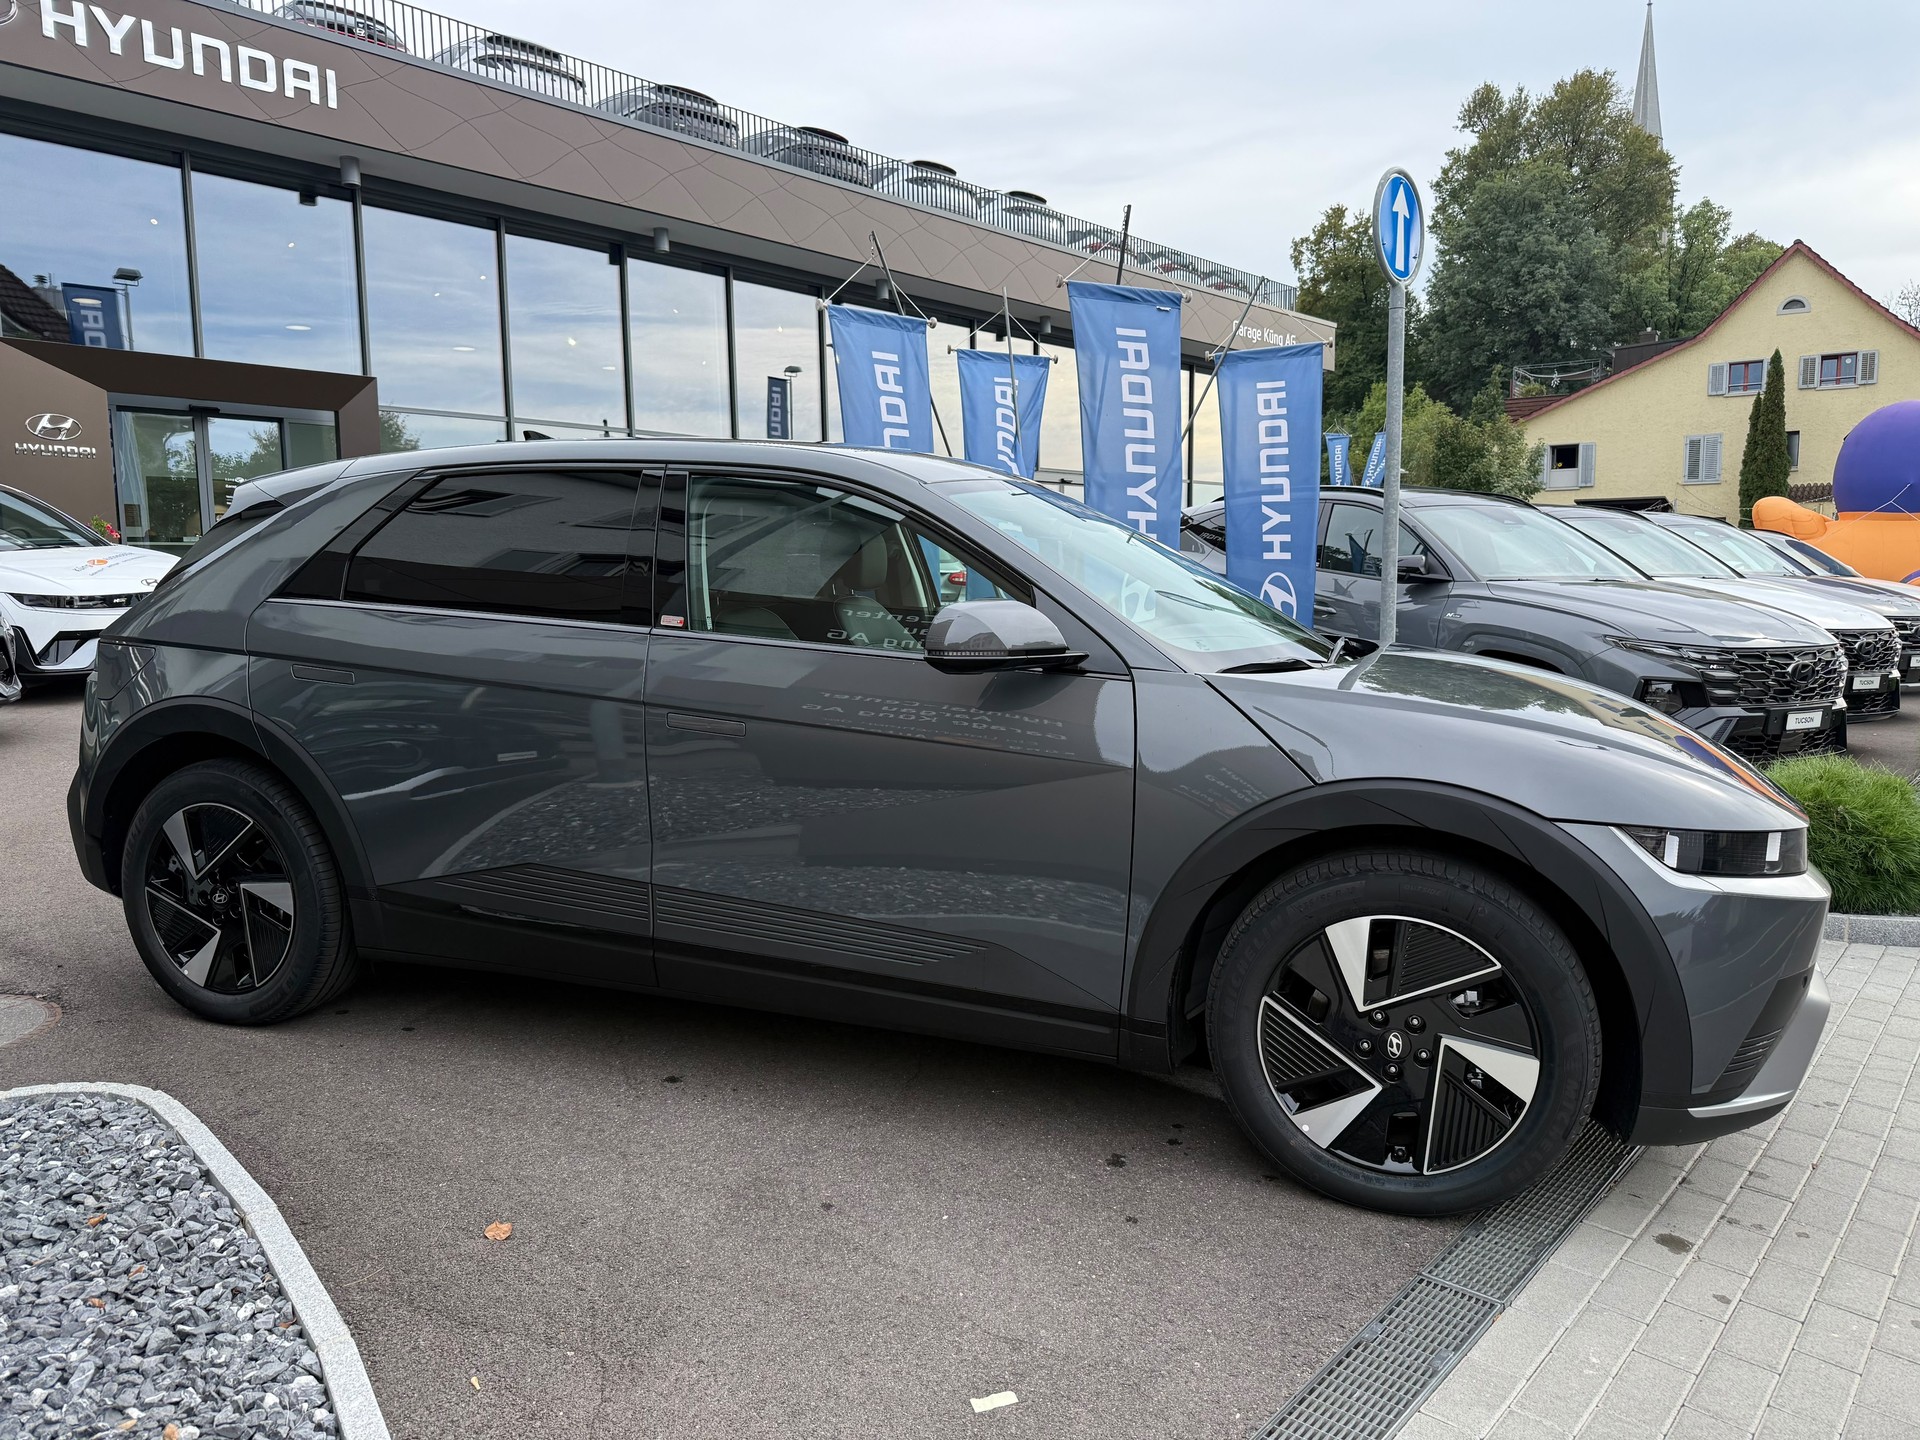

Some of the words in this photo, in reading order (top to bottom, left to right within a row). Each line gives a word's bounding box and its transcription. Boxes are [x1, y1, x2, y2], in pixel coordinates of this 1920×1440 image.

[40, 0, 338, 110] HYUNDAI
[14, 442, 97, 459] HYUNDAI
[1256, 380, 1292, 561] HYUNDAI
[1334, 444, 1343, 486] HYUNDAI
[1794, 715, 1815, 725] TUCSON
